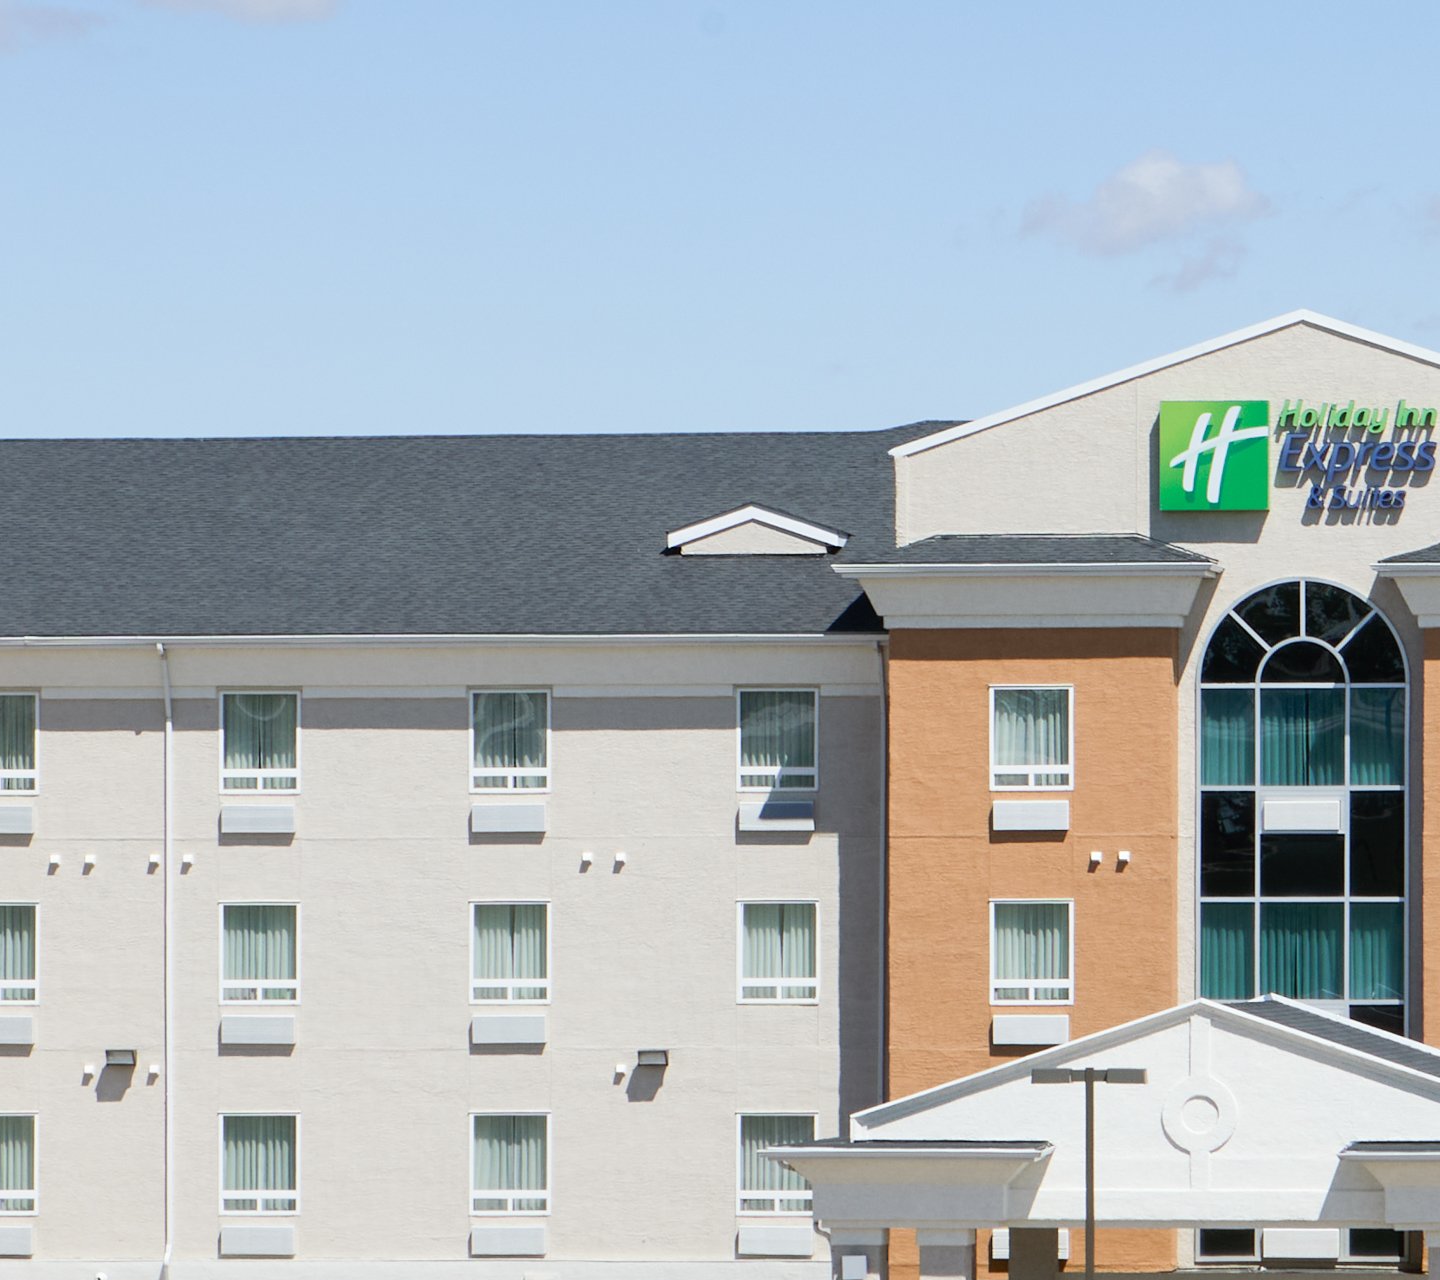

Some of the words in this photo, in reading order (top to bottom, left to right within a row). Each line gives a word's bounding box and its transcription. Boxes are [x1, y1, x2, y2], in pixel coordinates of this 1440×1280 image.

[1279, 399, 1388, 434] Holiday
[1395, 399, 1438, 427] Inn
[1280, 433, 1438, 482] Express
[1309, 483, 1323, 509] &
[1329, 485, 1406, 509] Suites
